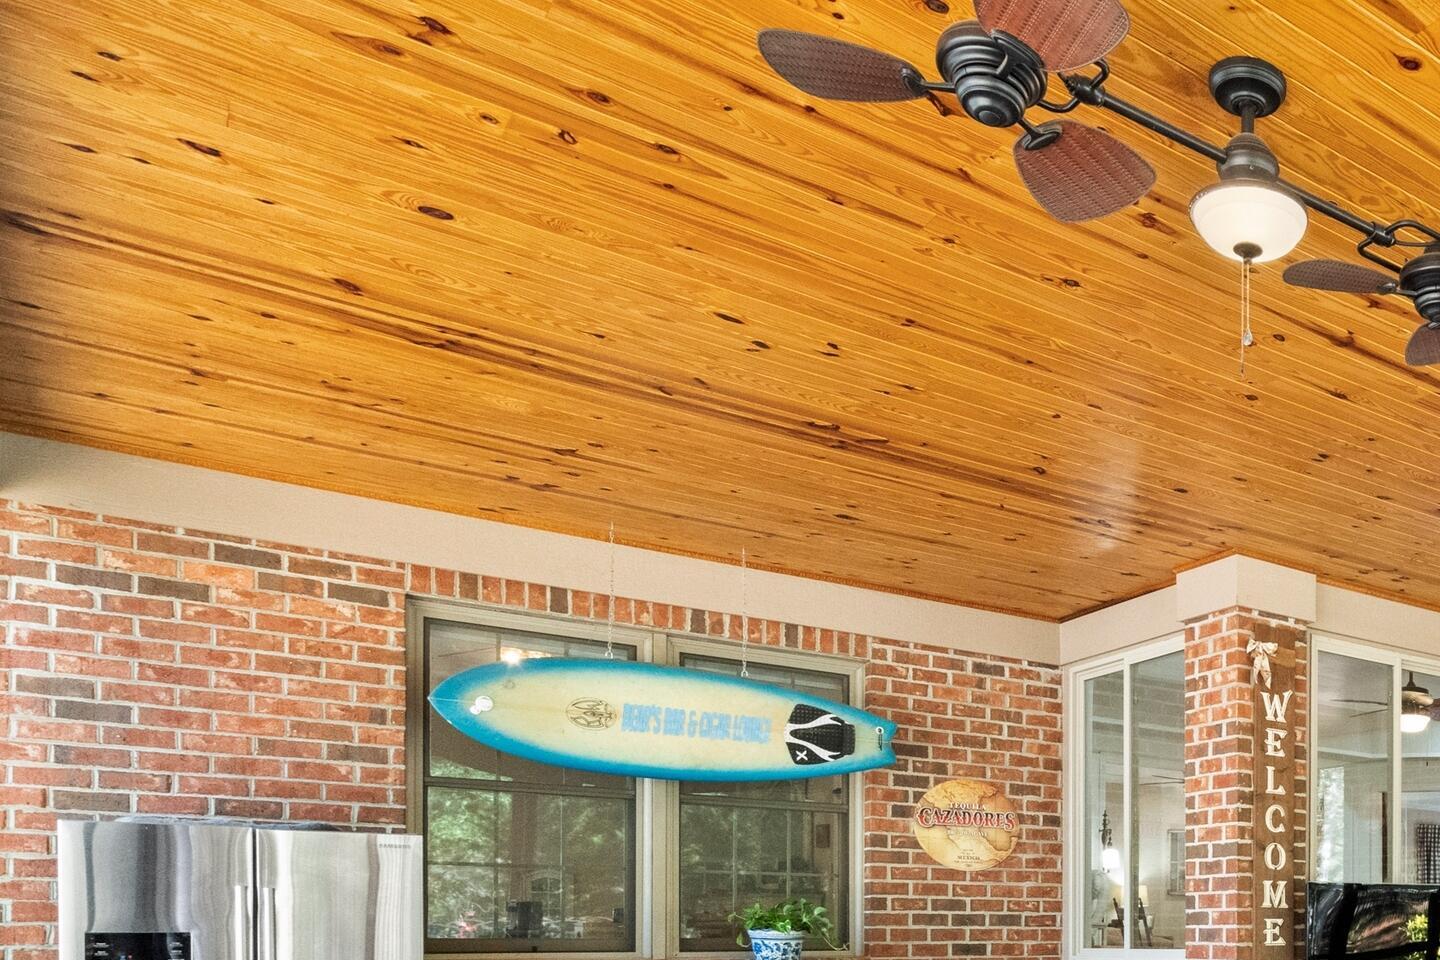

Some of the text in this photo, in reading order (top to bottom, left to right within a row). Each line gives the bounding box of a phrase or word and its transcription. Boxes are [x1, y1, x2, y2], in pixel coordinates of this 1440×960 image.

[917, 807, 1016, 832] CAZADORES
[949, 803, 987, 811] TEQUILA
[1260, 690, 1293, 946] WELCOME
